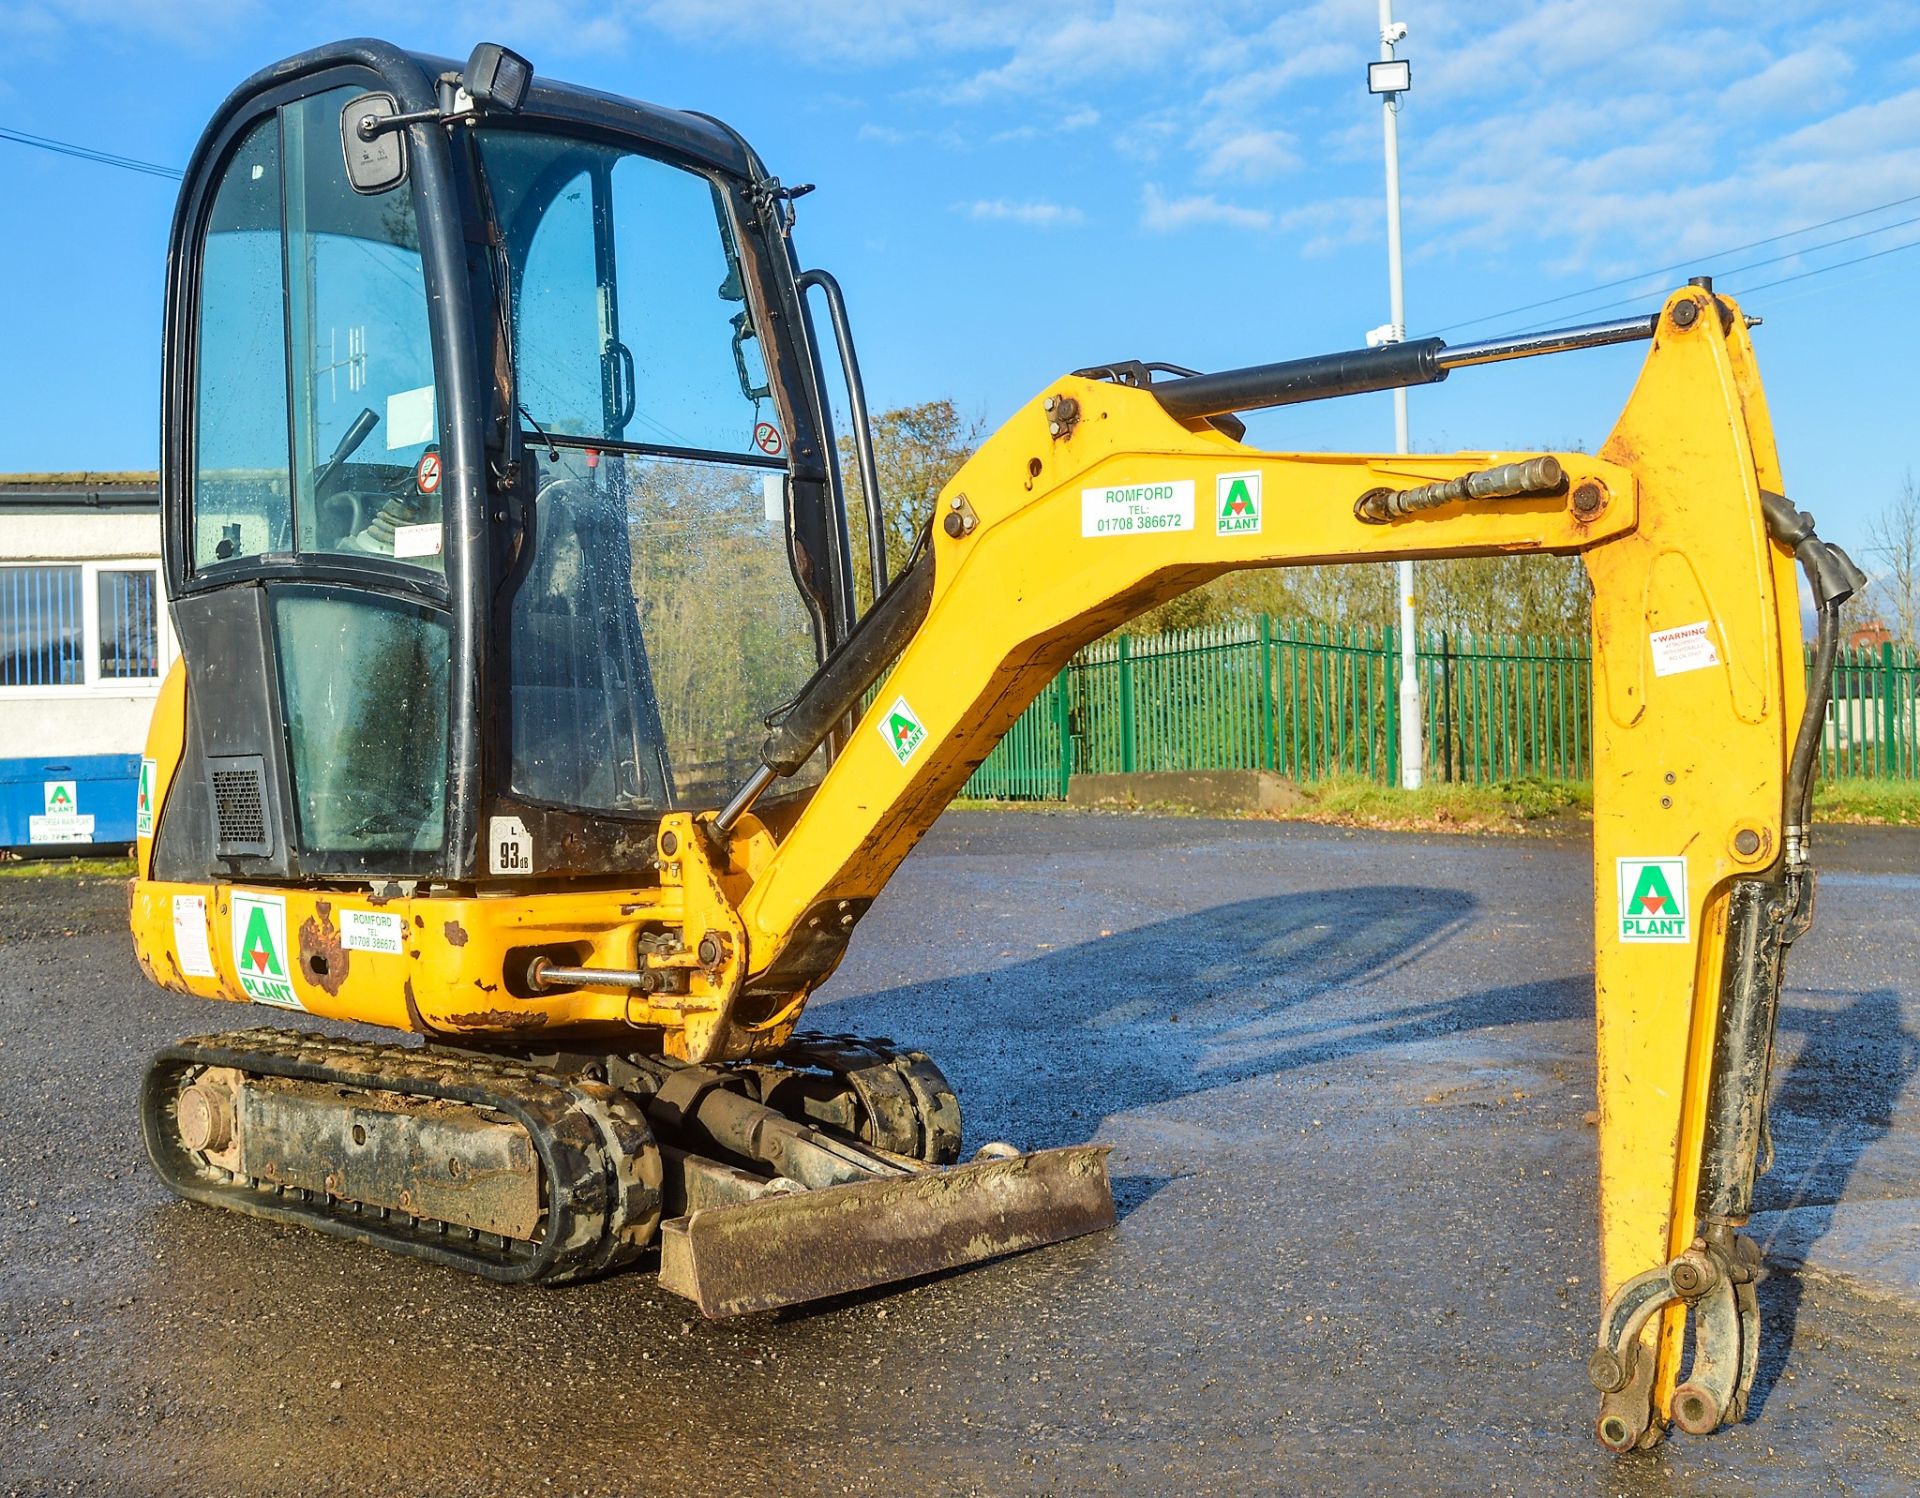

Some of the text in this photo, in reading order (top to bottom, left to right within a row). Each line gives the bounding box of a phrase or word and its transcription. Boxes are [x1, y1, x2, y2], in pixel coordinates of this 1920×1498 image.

[1105, 486, 1173, 503] ROMFORD
[1221, 480, 1256, 516] A
[1128, 505, 1150, 515] TEL:
[1097, 514, 1182, 532] 01708 386672
[1218, 517, 1259, 531] PLANT
[1658, 627, 1706, 643] WARNING
[889, 713, 917, 751] A
[898, 726, 924, 761] PLANT
[49, 785, 72, 804] A
[47, 805, 74, 813] PLANT
[1626, 865, 1681, 915] A
[353, 913, 392, 927] ROMFORD
[1622, 920, 1686, 935] PLANT
[240, 906, 284, 976] A
[241, 976, 295, 1003] PLANT
